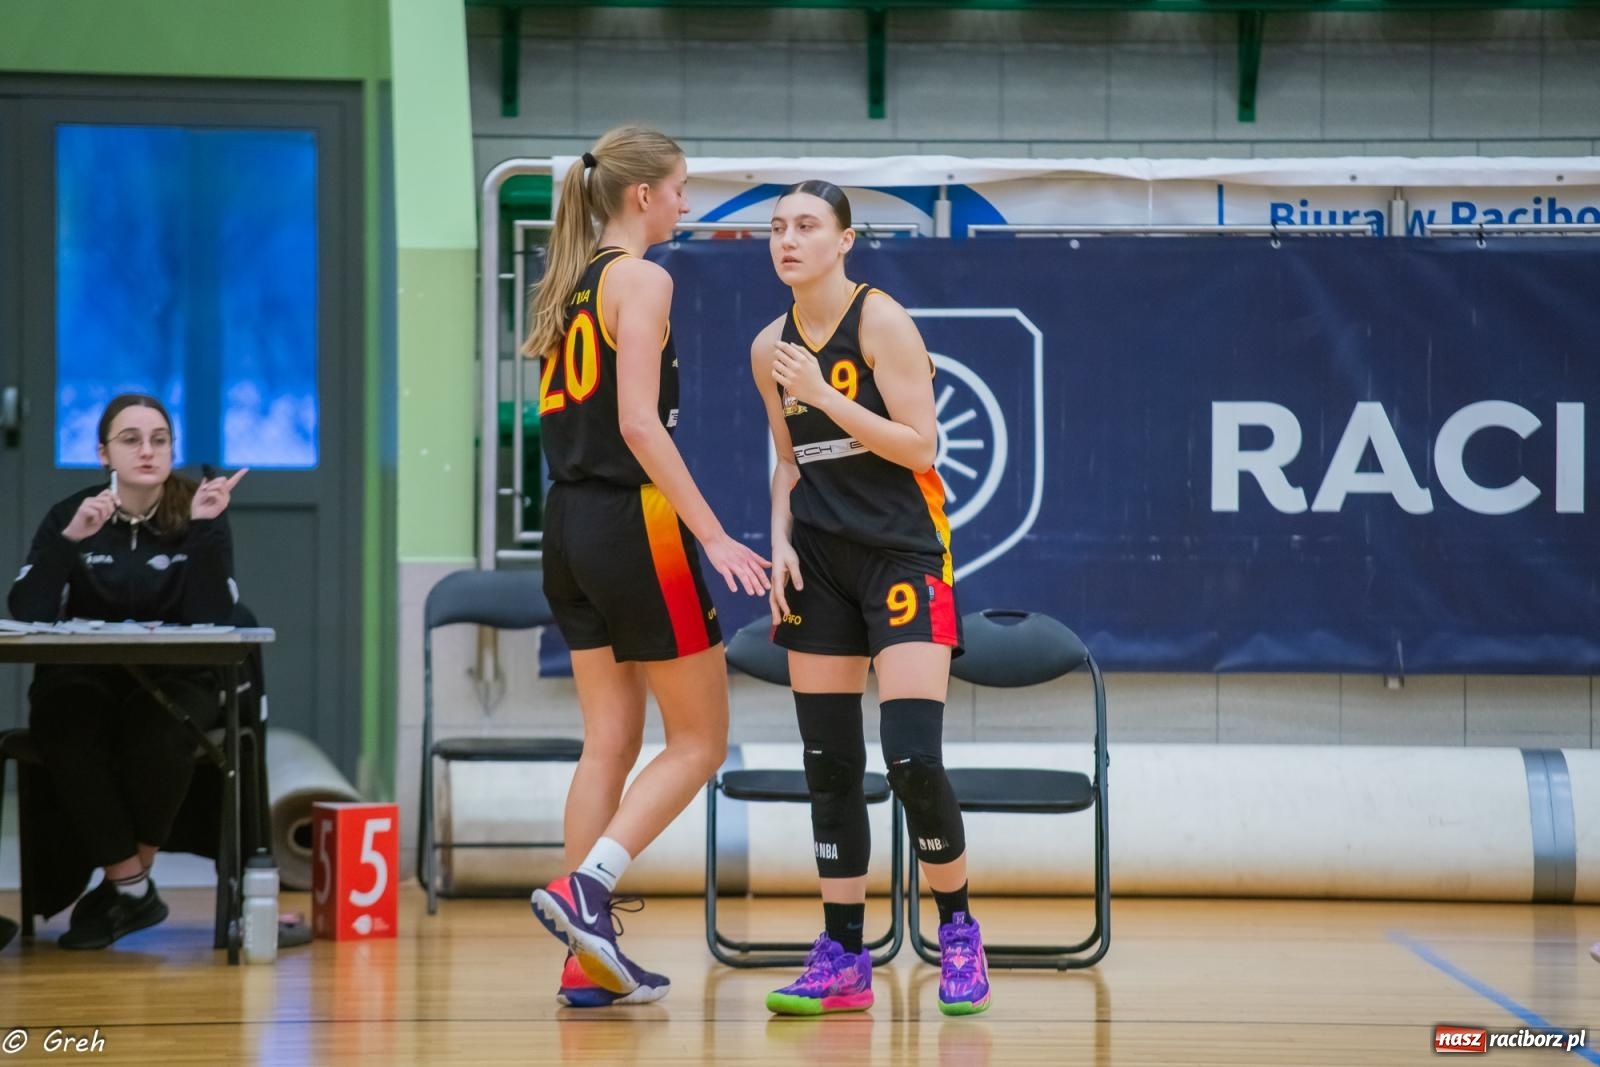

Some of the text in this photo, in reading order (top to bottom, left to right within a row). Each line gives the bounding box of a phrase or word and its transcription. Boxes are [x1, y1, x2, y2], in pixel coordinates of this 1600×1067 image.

[539, 309, 601, 416] 20
[829, 358, 860, 401] 9
[1210, 399, 1585, 515] RACI
[886, 581, 918, 627] 9
[314, 819, 333, 905] 5
[349, 817, 392, 907] 5
[819, 843, 838, 860] NBA
